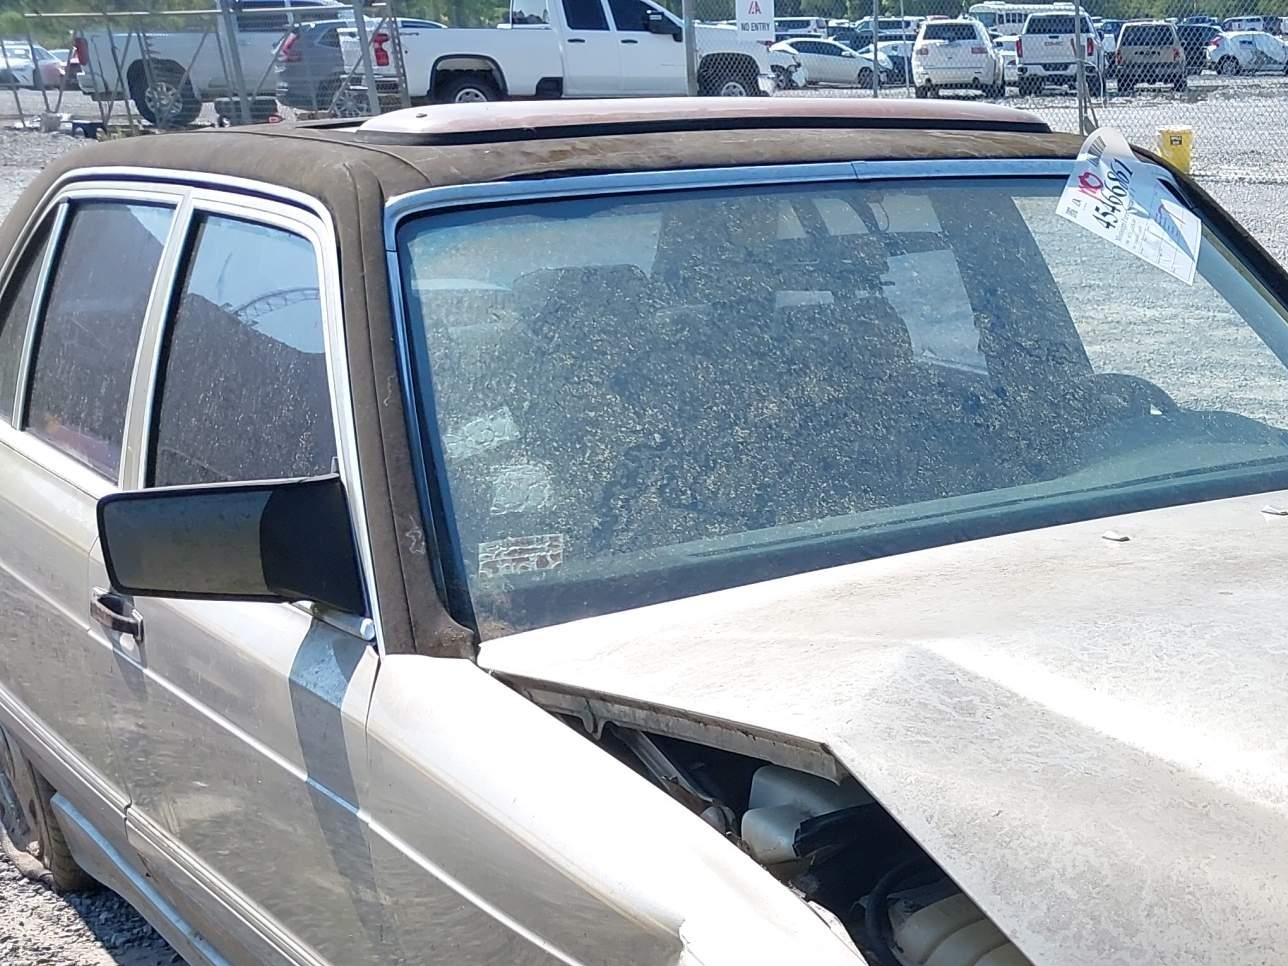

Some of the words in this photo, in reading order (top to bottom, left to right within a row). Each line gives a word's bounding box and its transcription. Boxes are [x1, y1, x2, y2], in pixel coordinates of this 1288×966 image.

[741, 22, 750, 32] NO
[751, 22, 770, 32] ENTRY
[1093, 158, 1133, 229] 45466861
